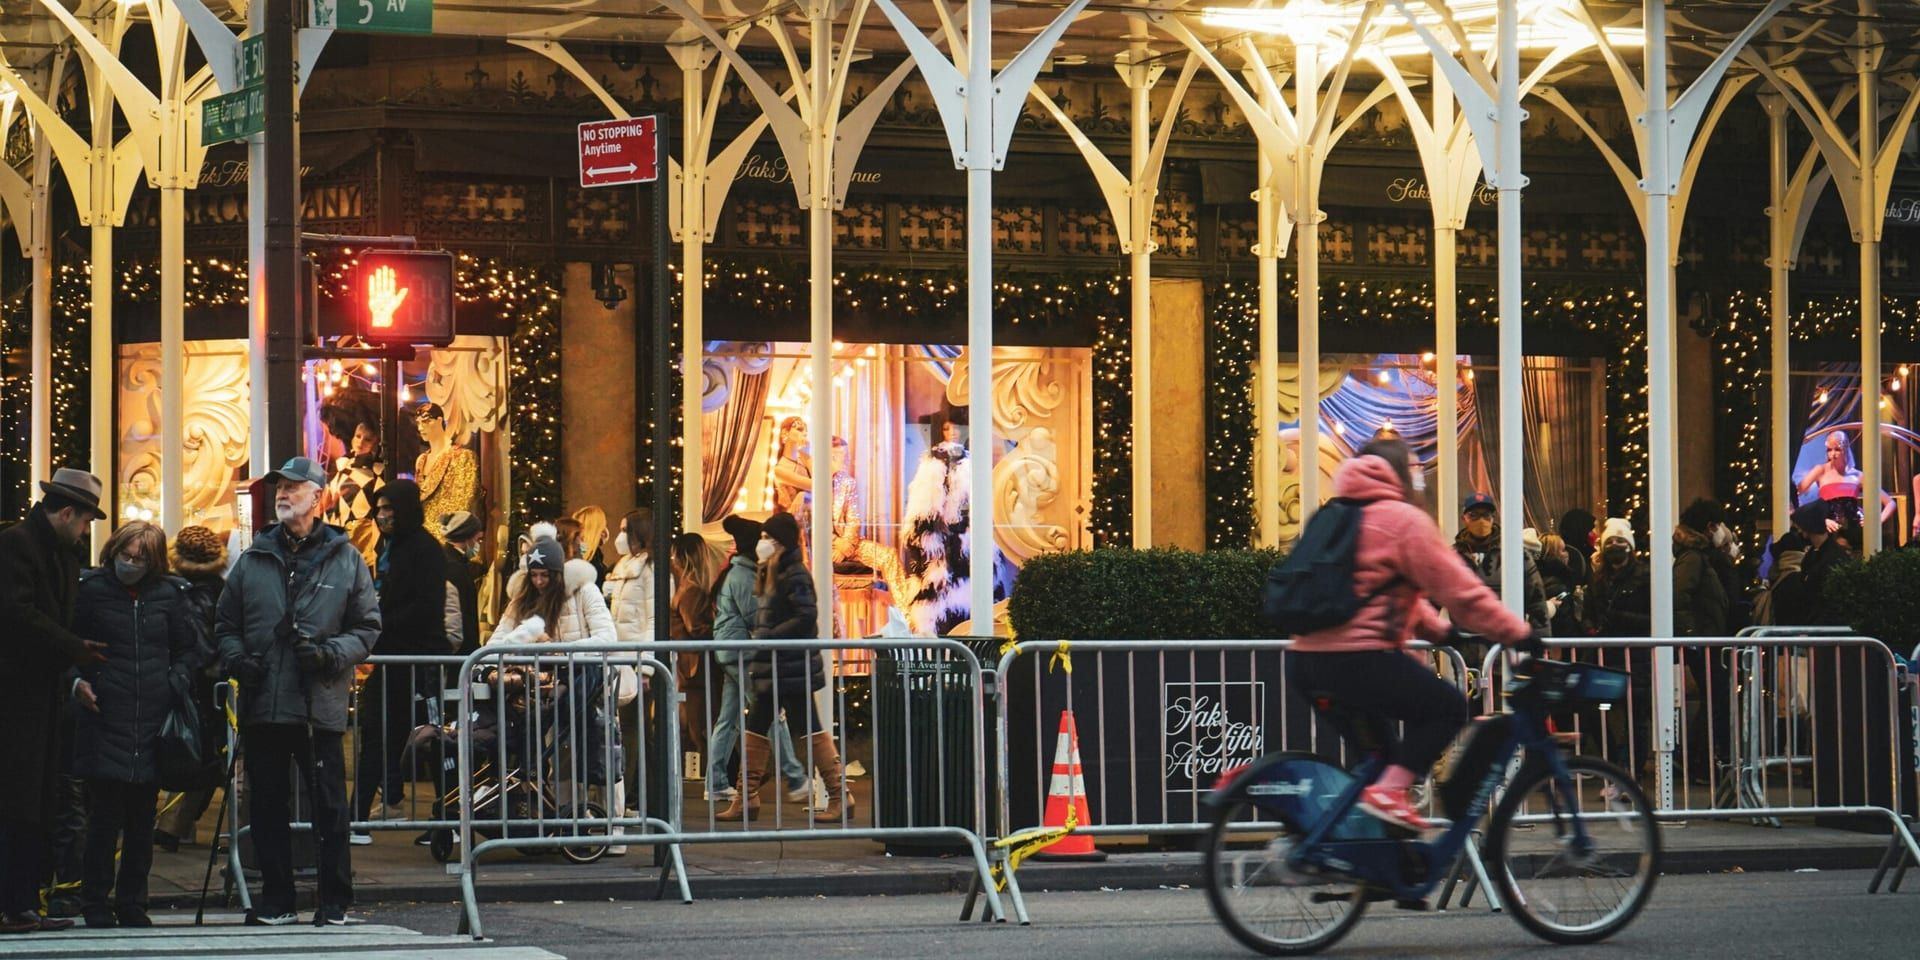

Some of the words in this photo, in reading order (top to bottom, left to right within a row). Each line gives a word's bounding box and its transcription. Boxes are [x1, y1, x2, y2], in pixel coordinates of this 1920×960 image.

[357, 0, 374, 24] 5
[386, 0, 407, 12] AV
[244, 46, 250, 80] E
[583, 129, 596, 141] NO
[598, 124, 643, 140] STOPPING
[584, 142, 622, 157] Anytime
